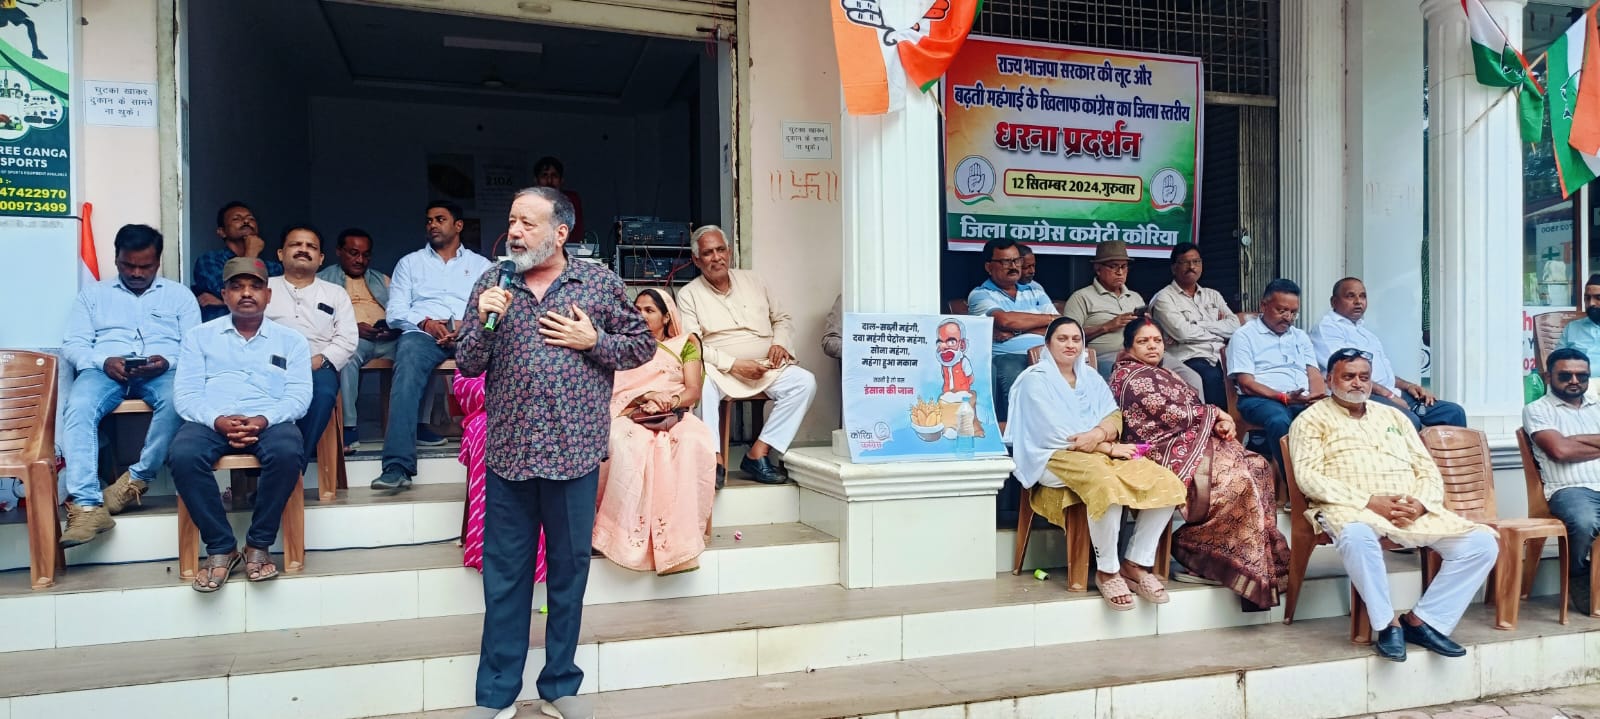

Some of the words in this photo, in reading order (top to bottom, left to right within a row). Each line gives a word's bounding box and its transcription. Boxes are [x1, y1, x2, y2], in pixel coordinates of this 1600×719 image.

[997, 56, 1022, 74] राज्य
[1024, 58, 1058, 77] भाजपा
[1060, 62, 1095, 80] सरकार
[1097, 61, 1113, 82] की
[1114, 67, 1131, 88] लूट
[1133, 64, 1152, 86] और
[954, 82, 985, 108] बढ़ती
[986, 86, 1025, 112] महंगाई
[1026, 87, 1039, 109] के
[1040, 87, 1080, 113] खिलाफ
[1081, 94, 1115, 116] कांग्रेस
[1116, 100, 1132, 117] का
[1133, 95, 1159, 119] जिला
[1160, 99, 1190, 121] स्तरीय
[995, 121, 1060, 152] धरना
[1062, 120, 1142, 158] प्रदर्शन
[23, 147, 68, 159] GANGA
[0, 157, 48, 168] SPORTS
[1011, 177, 1025, 190] 12
[1026, 173, 1067, 192] सितम्बर
[959, 215, 1007, 239] जिला
[1010, 220, 1066, 242] कांग्रेस
[1069, 222, 1120, 243] कमेटी
[1122, 223, 1179, 247] कोरिया
[852, 334, 866, 342] दवा
[870, 345, 888, 355] सोना
[886, 384, 897, 395] की
[897, 386, 914, 395] जान
